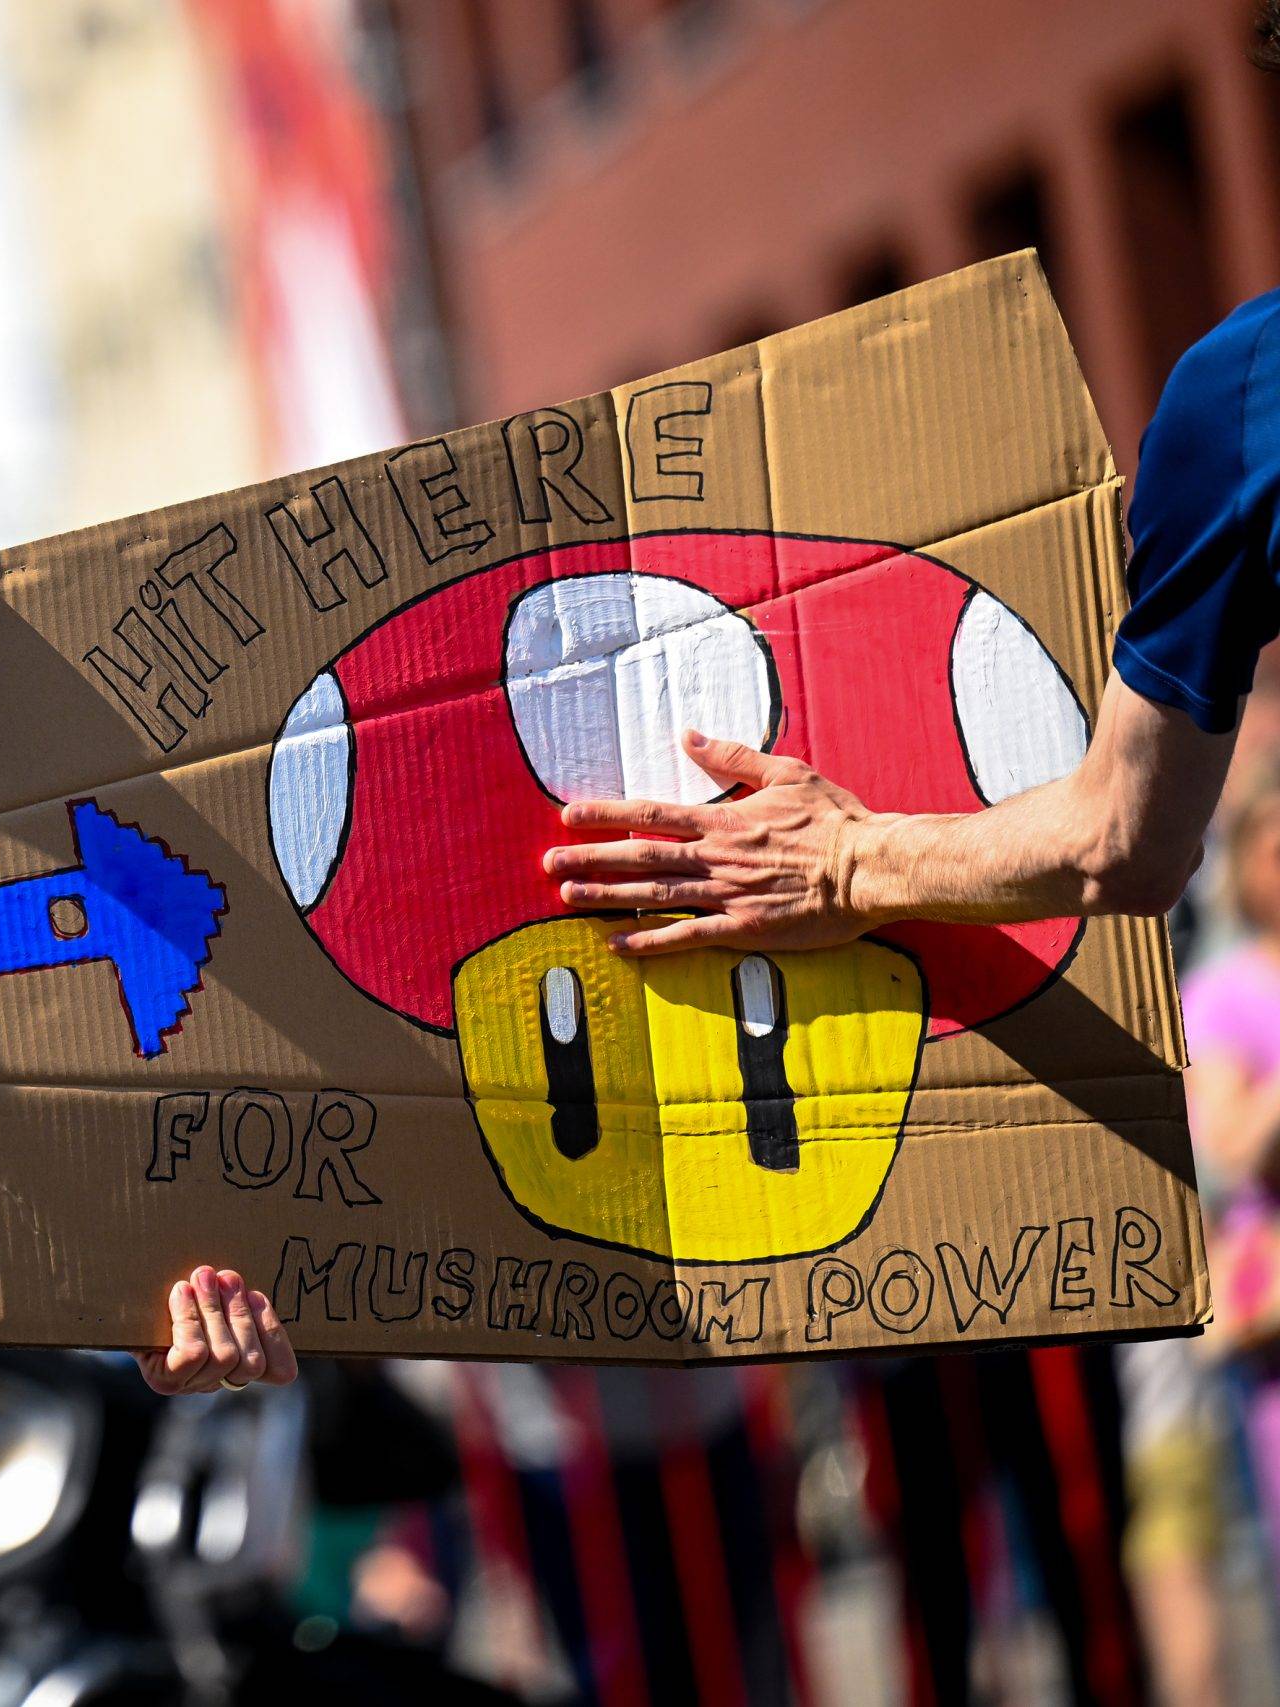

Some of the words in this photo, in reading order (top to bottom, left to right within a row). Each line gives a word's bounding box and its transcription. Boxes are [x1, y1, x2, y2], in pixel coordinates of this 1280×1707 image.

[265, 382, 712, 611] HERE
[145, 1086, 383, 1208] FOR
[274, 1235, 770, 1343] MUSHROOM
[805, 1206, 1180, 1343] POWER
